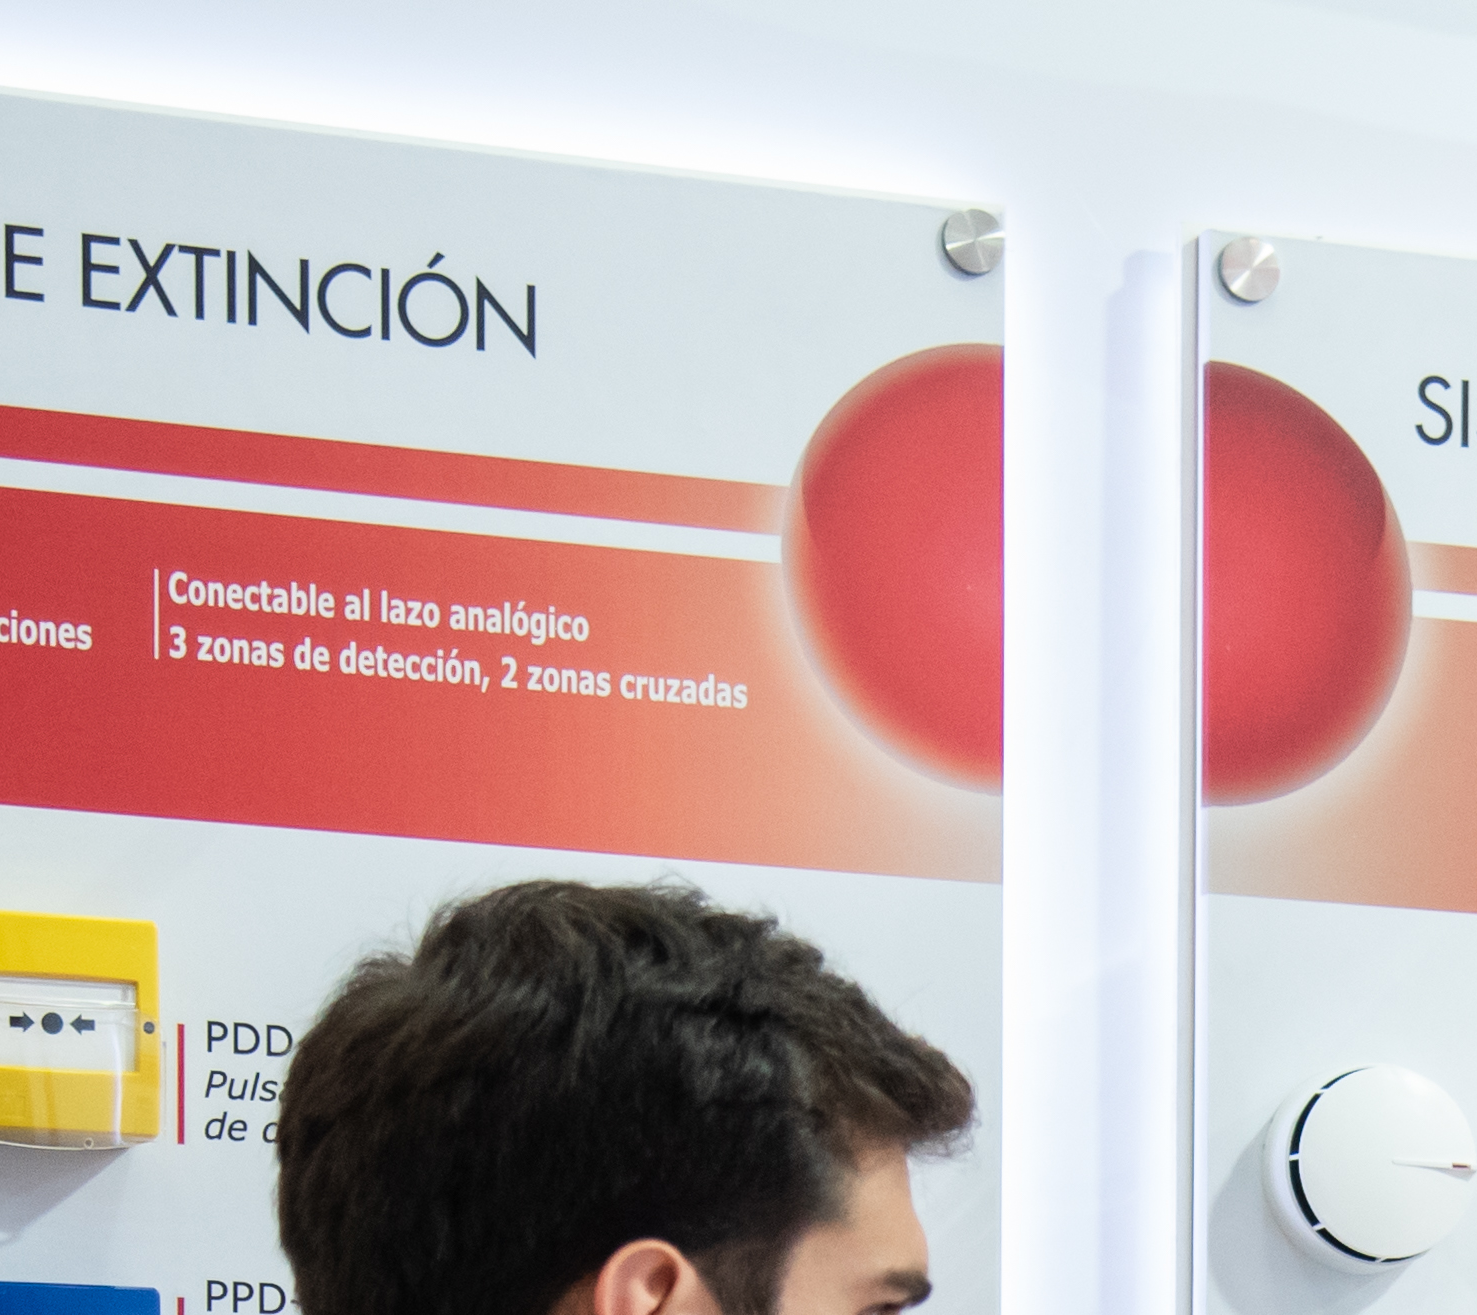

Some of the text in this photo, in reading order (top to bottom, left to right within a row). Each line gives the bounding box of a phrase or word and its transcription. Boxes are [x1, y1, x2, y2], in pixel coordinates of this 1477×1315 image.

[81, 232, 536, 358] EXTINCIÓN
[168, 570, 590, 646] Conectable al lazo analógico
[169, 625, 749, 710] 3 zonas de detección, 2 zonas cruzadas
[204, 1070, 279, 1102] Puls
[204, 1111, 248, 1141] de
